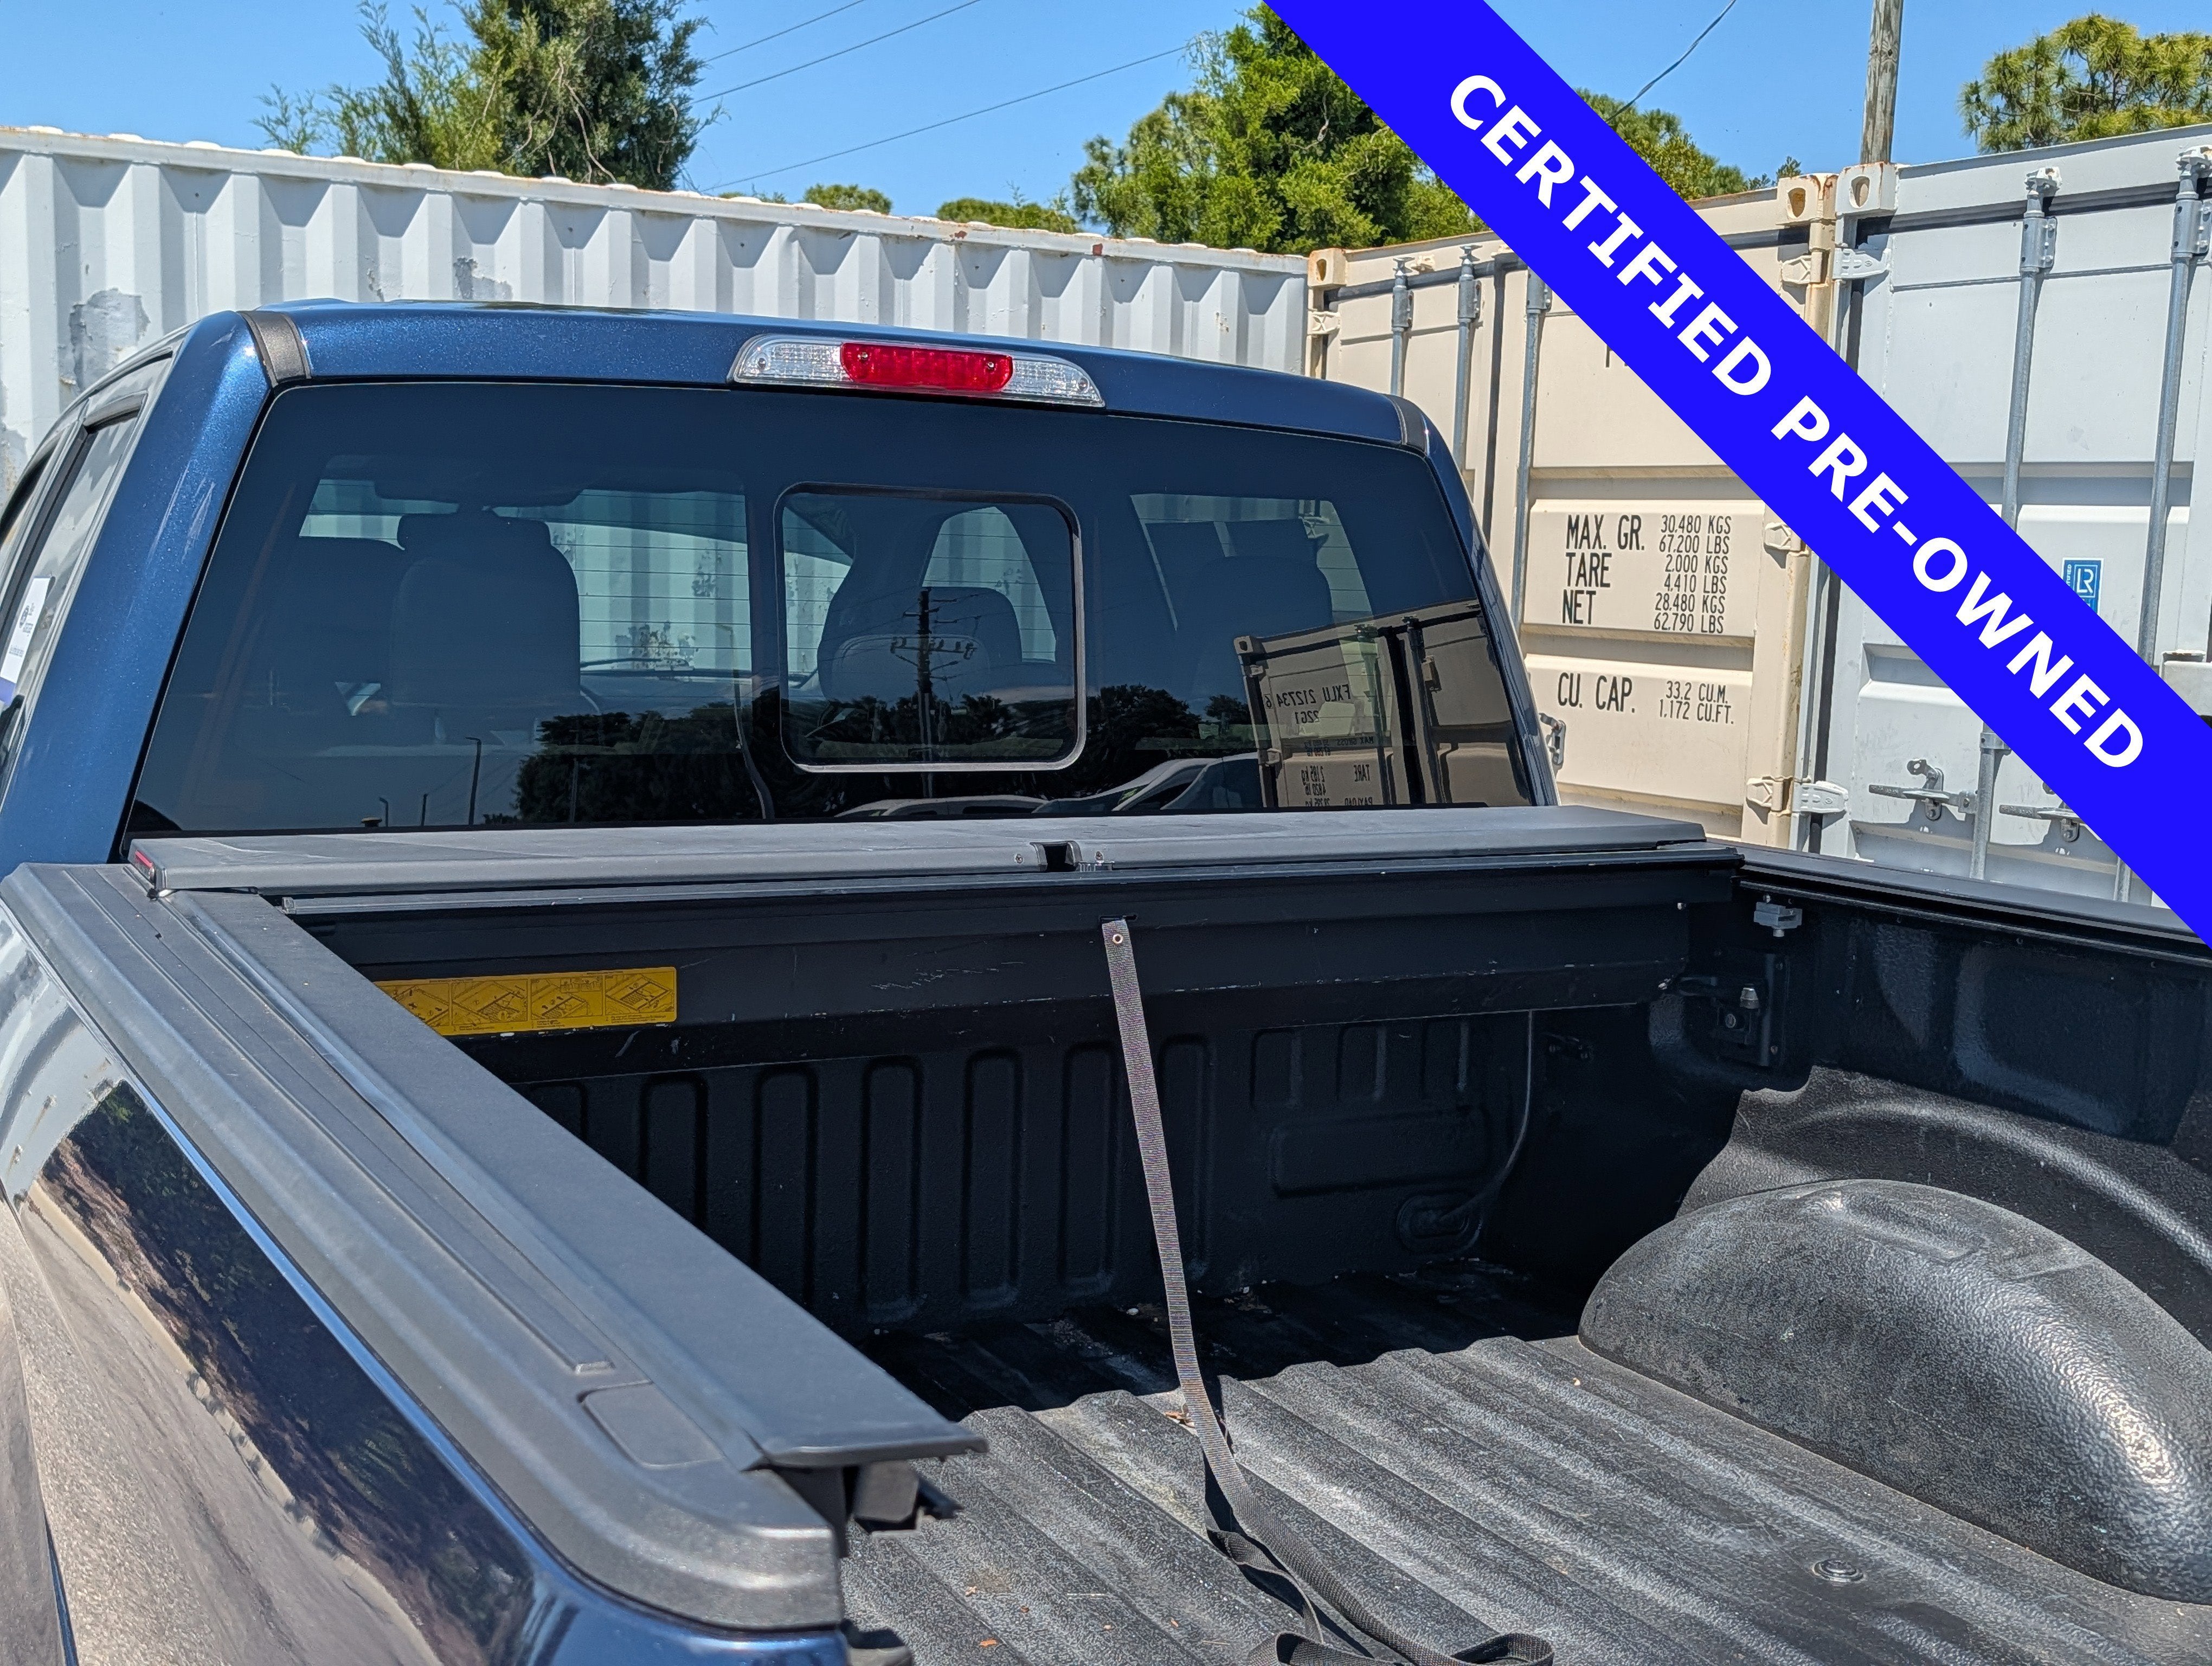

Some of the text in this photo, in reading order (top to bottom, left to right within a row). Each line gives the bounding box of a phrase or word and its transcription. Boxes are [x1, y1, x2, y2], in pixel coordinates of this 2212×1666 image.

[1566, 515, 1606, 549] MAX.
[1617, 515, 1644, 550] GR.
[1708, 515, 1732, 534] KGS
[1706, 535, 1730, 554] LBS
[1565, 552, 1612, 588] TARE
[1705, 555, 1728, 574] KGS
[2076, 568, 2094, 593] LR
[1703, 575, 1727, 594] LBS
[1562, 589, 1596, 624] NET
[1702, 594, 1725, 614] KGS
[1700, 614, 1724, 633] LBS
[1558, 672, 1728, 713] CU. CAP. 33.2 CU.M.
[1697, 703, 1734, 725] CU.FT.
